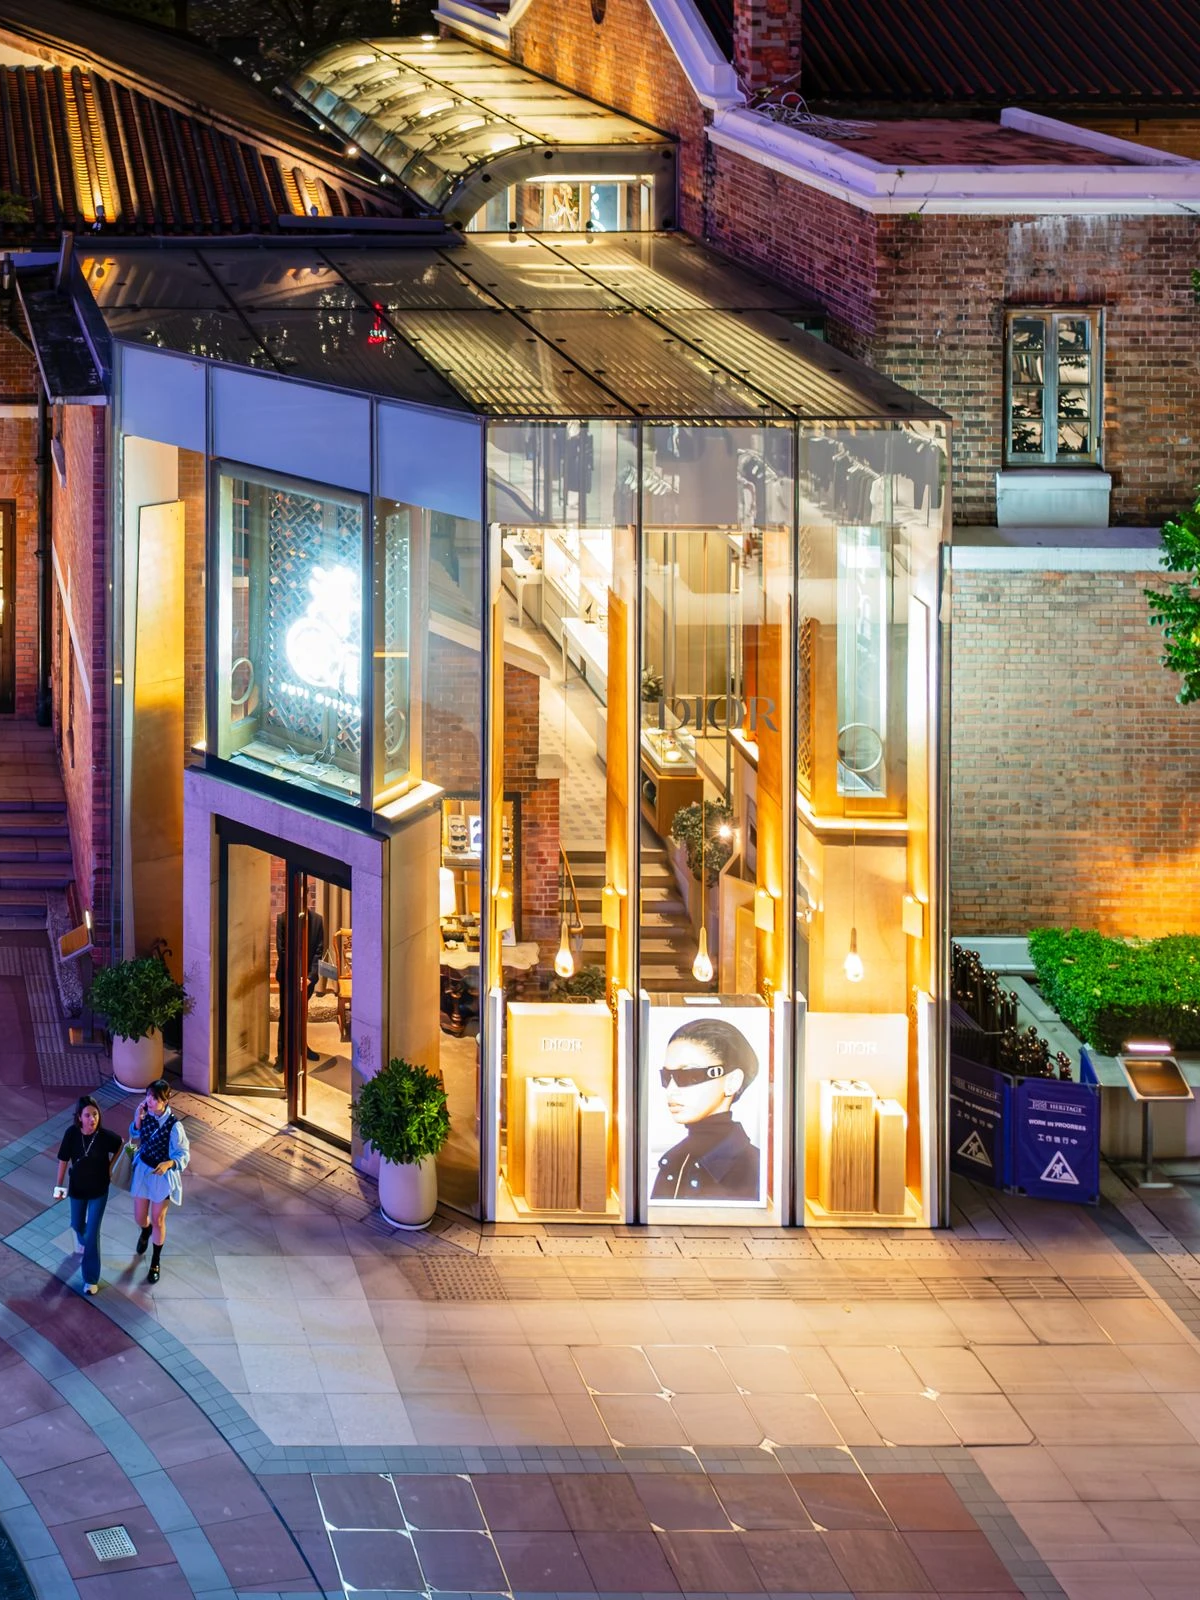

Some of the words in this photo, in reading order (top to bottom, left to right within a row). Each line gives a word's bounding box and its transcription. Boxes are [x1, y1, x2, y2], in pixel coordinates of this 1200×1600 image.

[657, 696, 779, 732] DIOR
[1049, 1103, 1082, 1113] HERITAGE
[1054, 1121, 1087, 1131] PROGRESS
